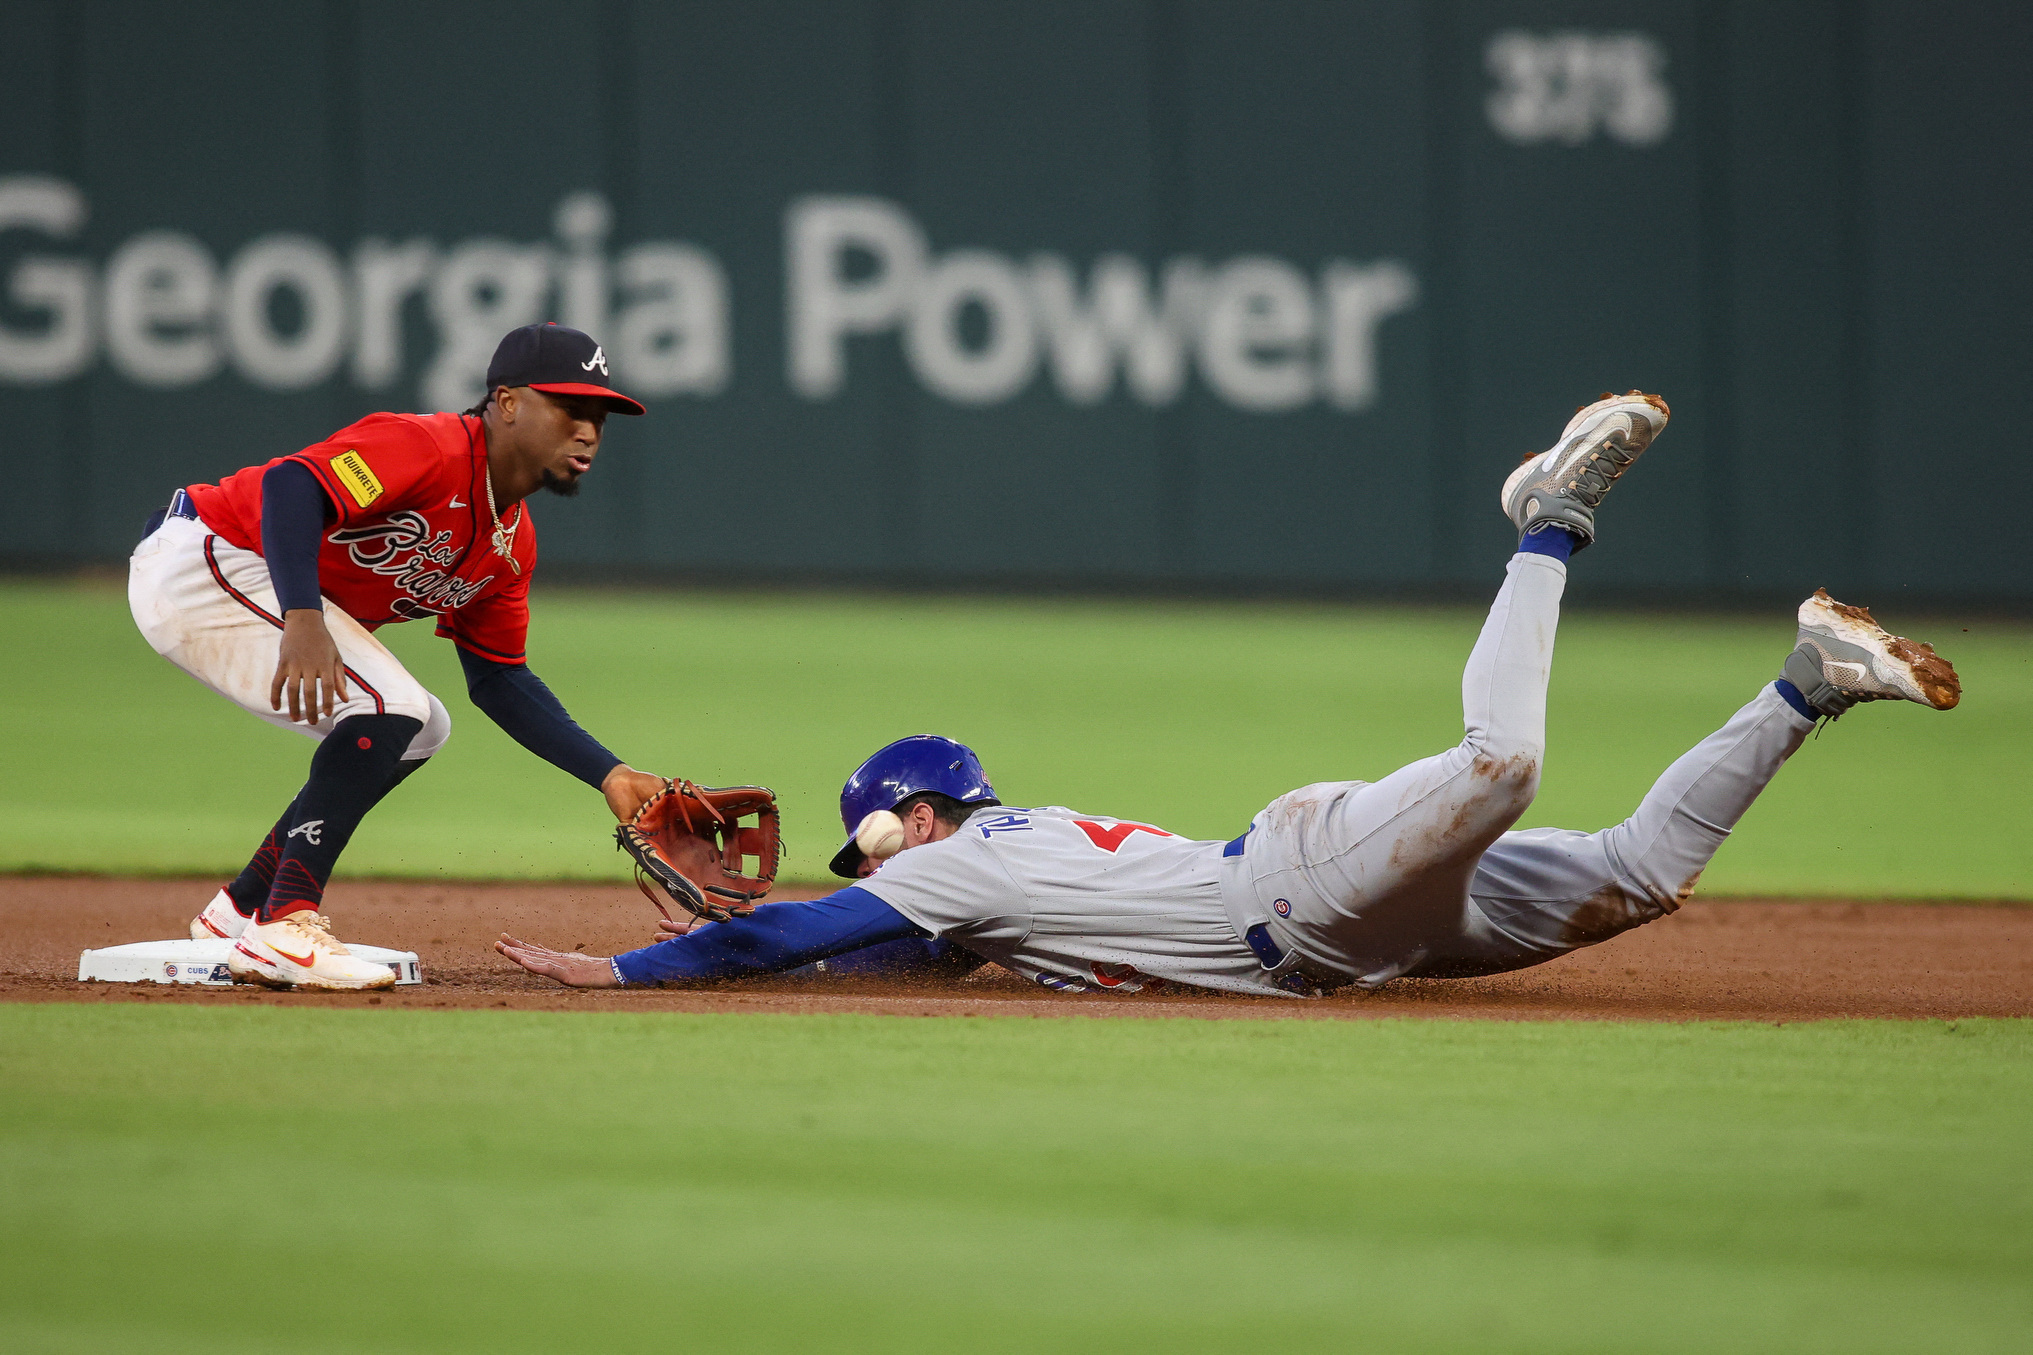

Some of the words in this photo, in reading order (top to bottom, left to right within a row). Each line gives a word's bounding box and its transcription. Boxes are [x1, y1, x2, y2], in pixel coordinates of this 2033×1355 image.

[0, 176, 732, 412] Georgia
[783, 195, 1418, 410] Power
[581, 346, 609, 377] A
[343, 456, 378, 498] QUIKRETE
[416, 530, 463, 567] Los
[187, 967, 209, 975] CUBS
